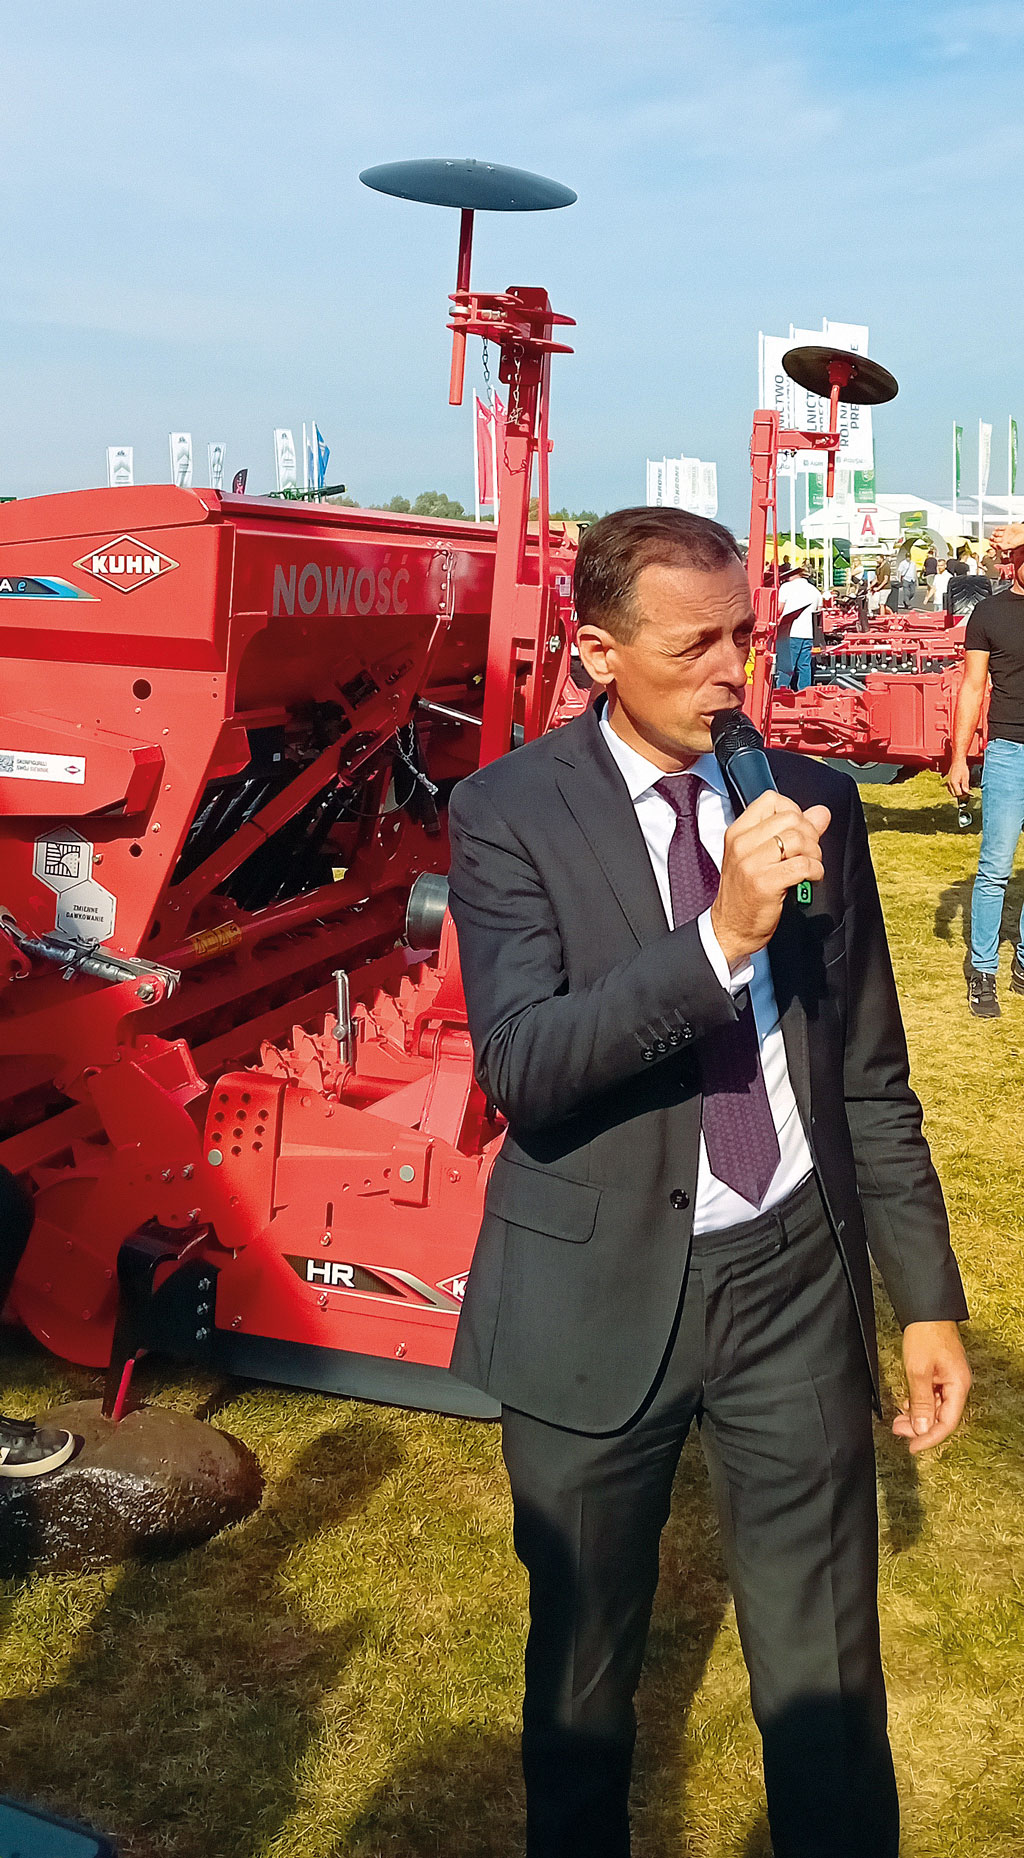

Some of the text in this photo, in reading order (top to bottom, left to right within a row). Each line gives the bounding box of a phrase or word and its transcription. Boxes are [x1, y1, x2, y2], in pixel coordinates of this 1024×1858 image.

[860, 514, 876, 536] A
[92, 555, 161, 575] KUHN
[272, 552, 410, 617] NOWOŚĆ
[306, 1259, 356, 1289] HR
